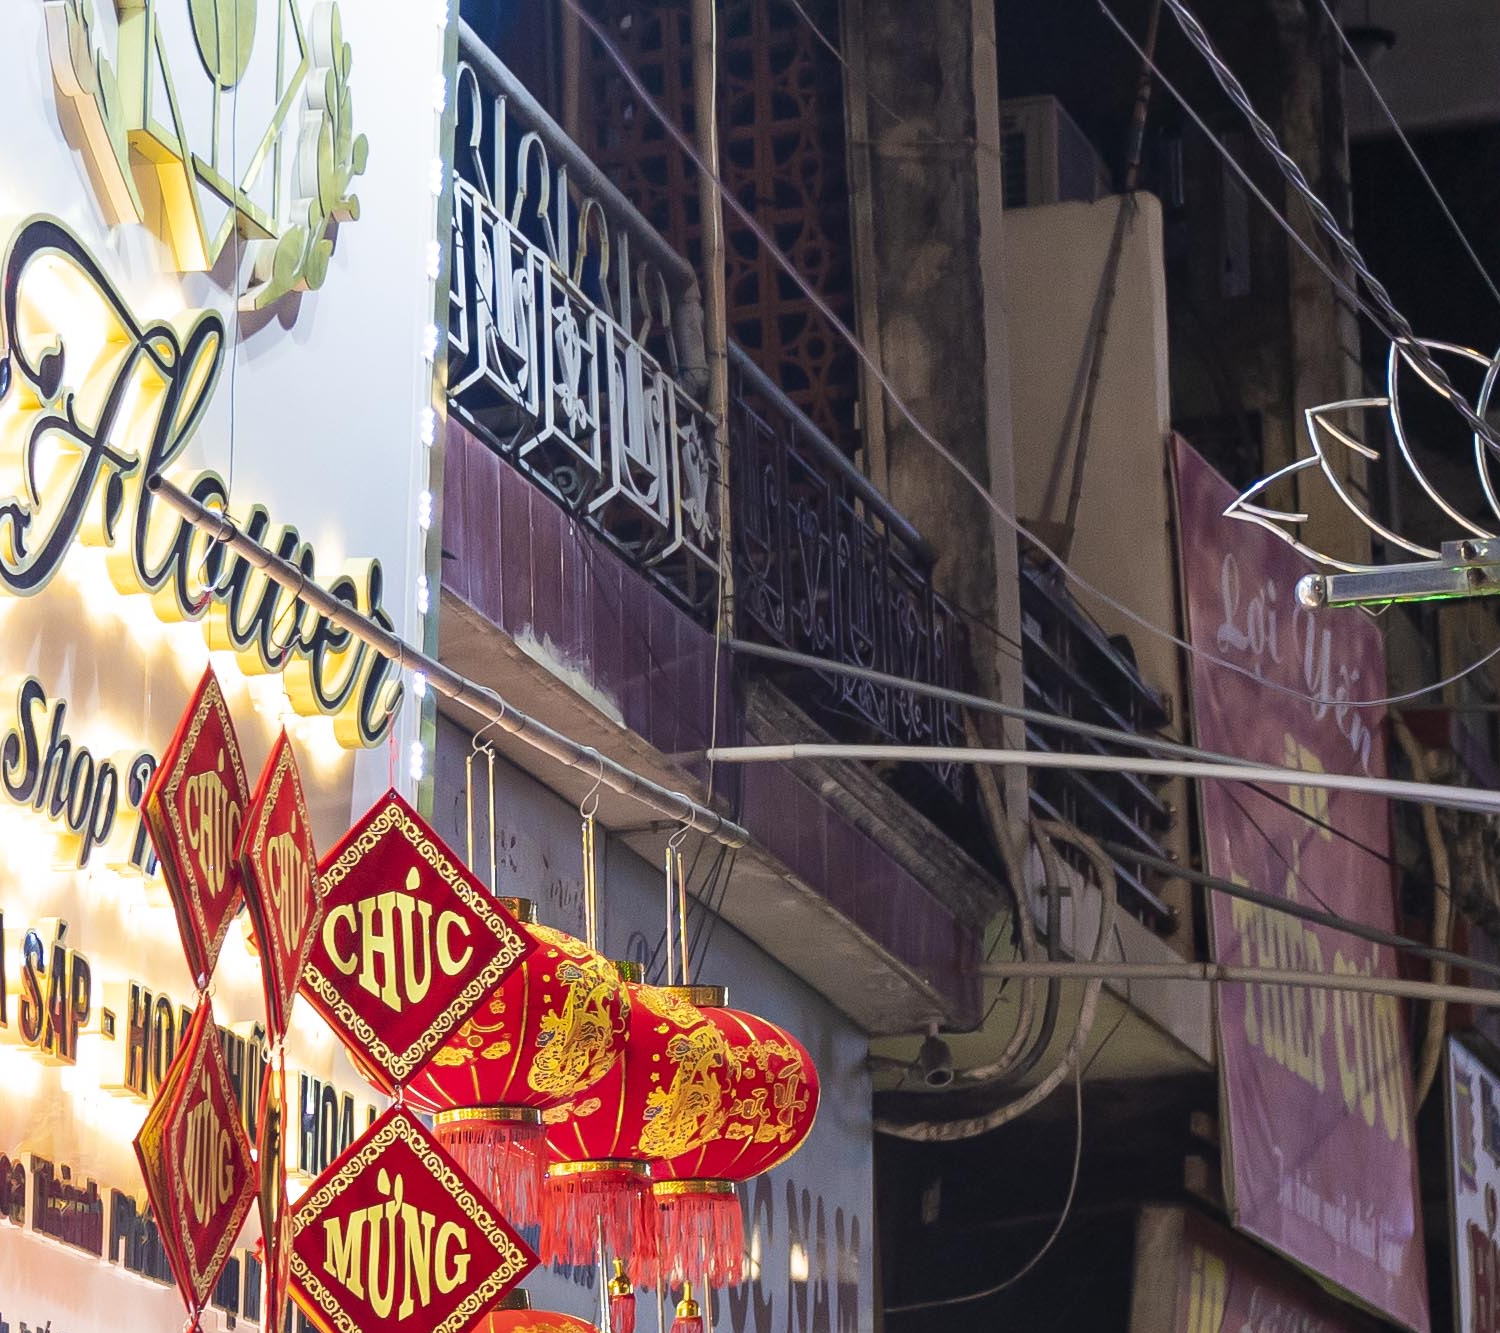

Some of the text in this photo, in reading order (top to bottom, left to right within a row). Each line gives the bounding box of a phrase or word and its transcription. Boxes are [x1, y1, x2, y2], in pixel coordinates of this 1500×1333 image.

[2, 676, 119, 846] Shop
[18, 916, 92, 1067] SÁP
[322, 865, 474, 1013] CHÚC
[322, 1166, 472, 1321] MỪNG
